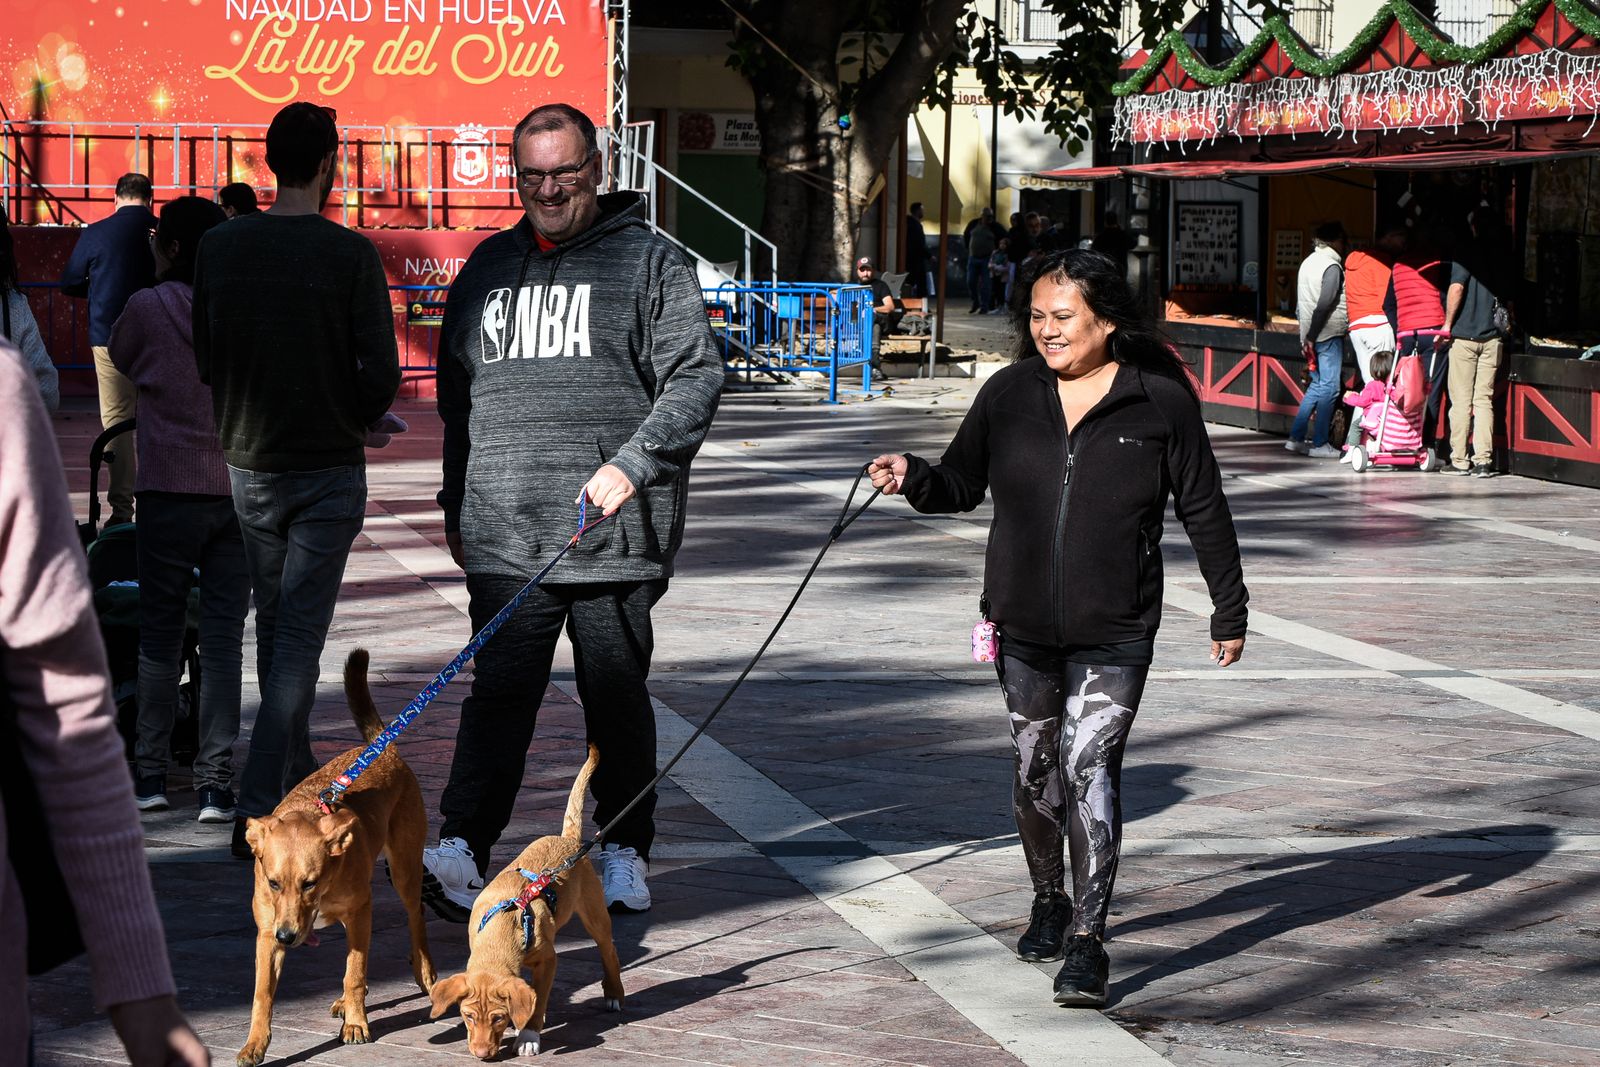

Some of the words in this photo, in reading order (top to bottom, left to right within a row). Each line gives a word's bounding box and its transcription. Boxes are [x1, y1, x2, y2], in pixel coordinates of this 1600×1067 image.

[225, 0, 372, 22] NAVIDAD
[383, 0, 426, 23] EN
[438, 0, 566, 25] HUELVA
[204, 10, 299, 104] La
[295, 23, 365, 96] luz
[372, 25, 437, 76] del
[451, 15, 564, 85] Sur
[724, 131, 738, 142] Las
[726, 119, 754, 130] Plaza
[508, 284, 592, 359] NBA
